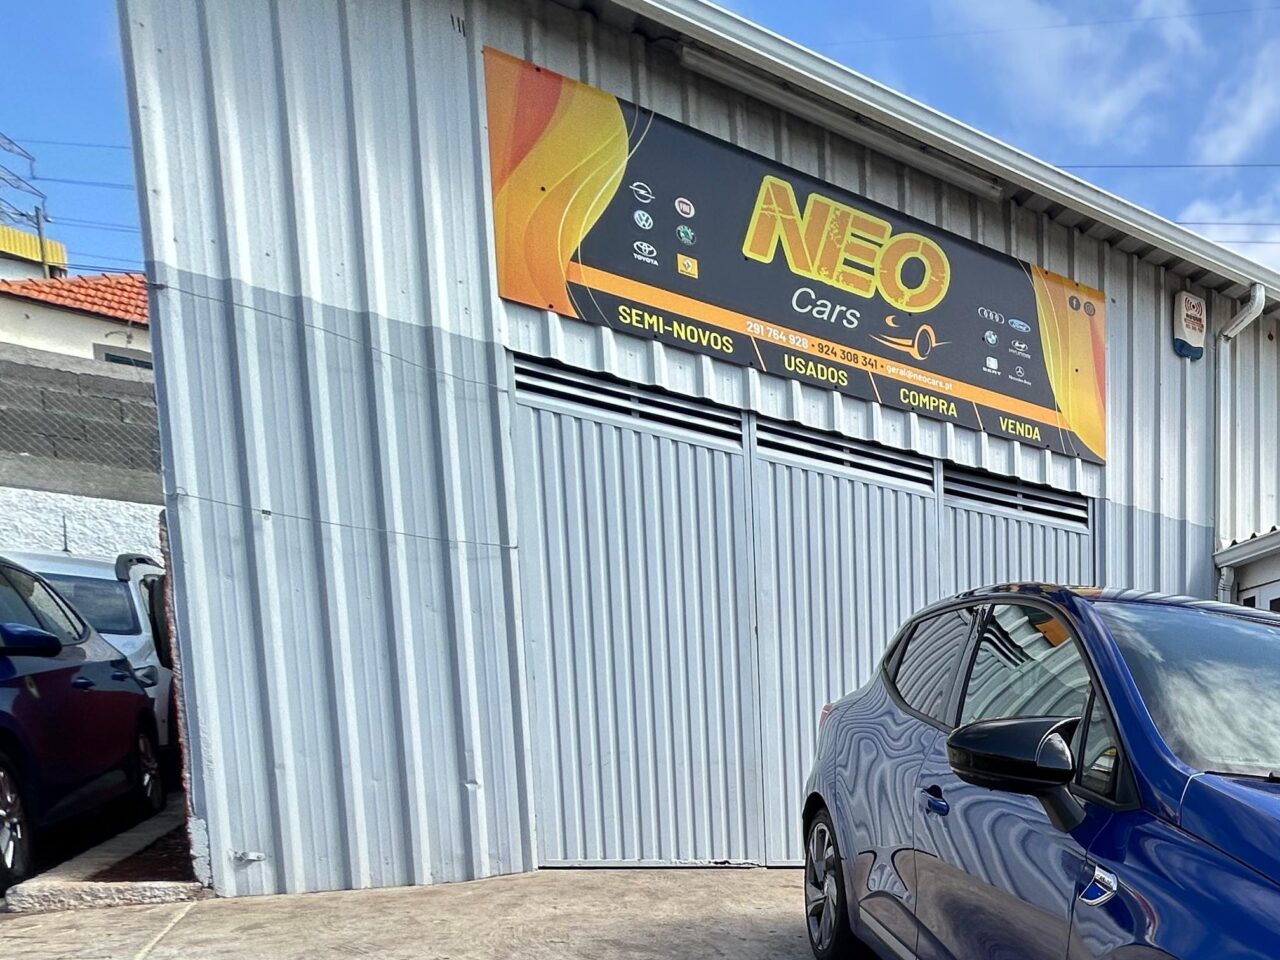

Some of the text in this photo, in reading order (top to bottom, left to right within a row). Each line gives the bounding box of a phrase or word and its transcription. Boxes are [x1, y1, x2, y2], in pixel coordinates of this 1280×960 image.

[633, 253, 659, 267] TOYOTA
[742, 175, 950, 313] NEO
[791, 287, 861, 329] Cars
[618, 305, 734, 354] SEMI-NOVOS
[745, 320, 953, 391] 291 764 928 924 308 341 geral@neocars.pt
[784, 353, 849, 386] USADOS
[900, 387, 958, 418] COMPRA
[999, 416, 1041, 442] VENDA
